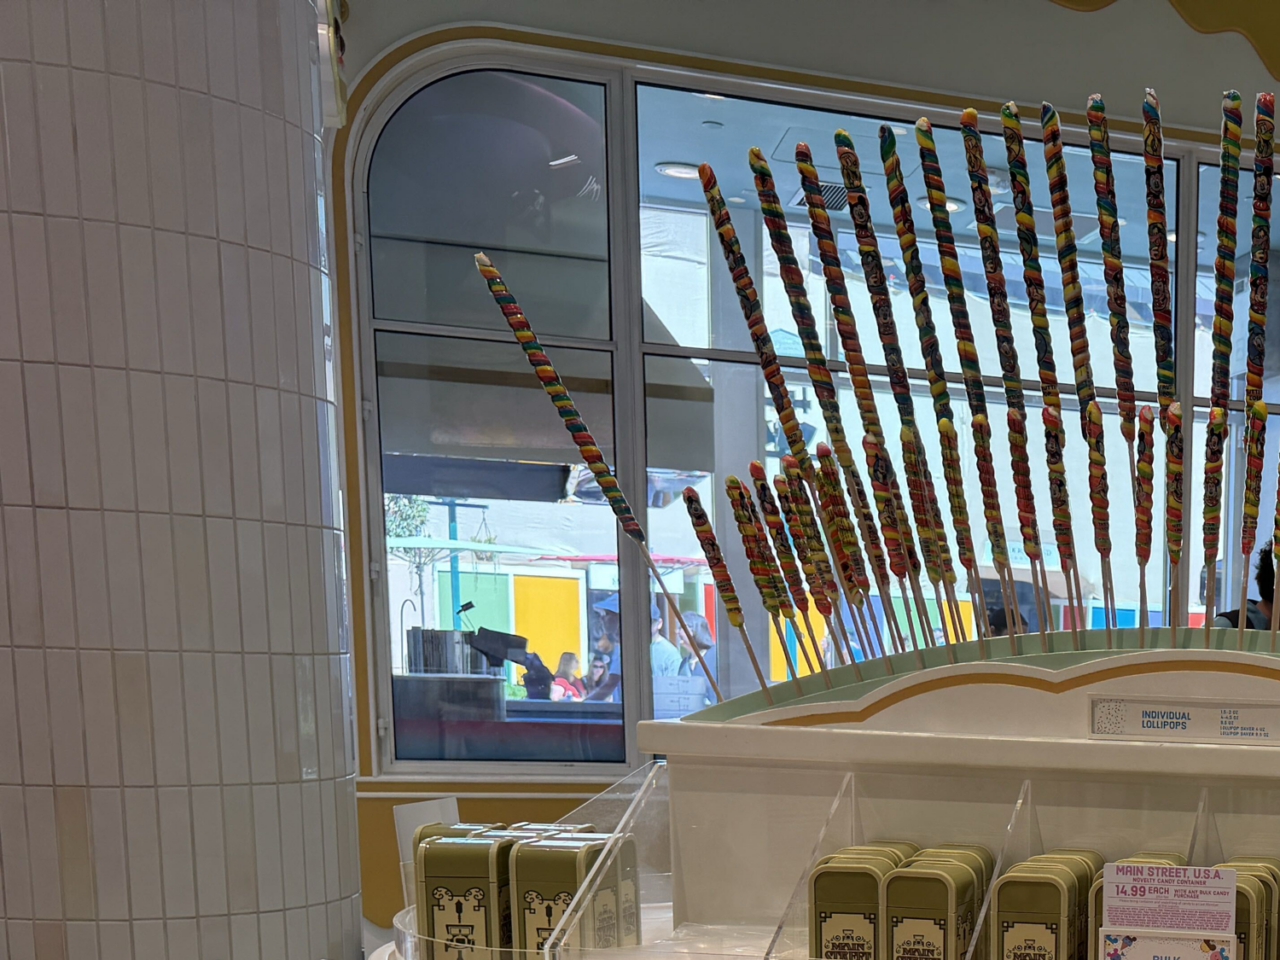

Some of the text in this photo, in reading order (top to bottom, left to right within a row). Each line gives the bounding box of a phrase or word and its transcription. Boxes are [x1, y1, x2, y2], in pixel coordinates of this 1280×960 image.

[1142, 710, 1191, 720] INDIVIDUAL
[1142, 720, 1187, 730] LOLLIPOPS
[1116, 865, 1223, 880] MAIN STREET, U.S.A.
[1115, 885, 1146, 897] 14.99
[831, 942, 865, 951] MAIN
[902, 948, 935, 956] MAIN
[1013, 952, 1046, 960] MAIN
